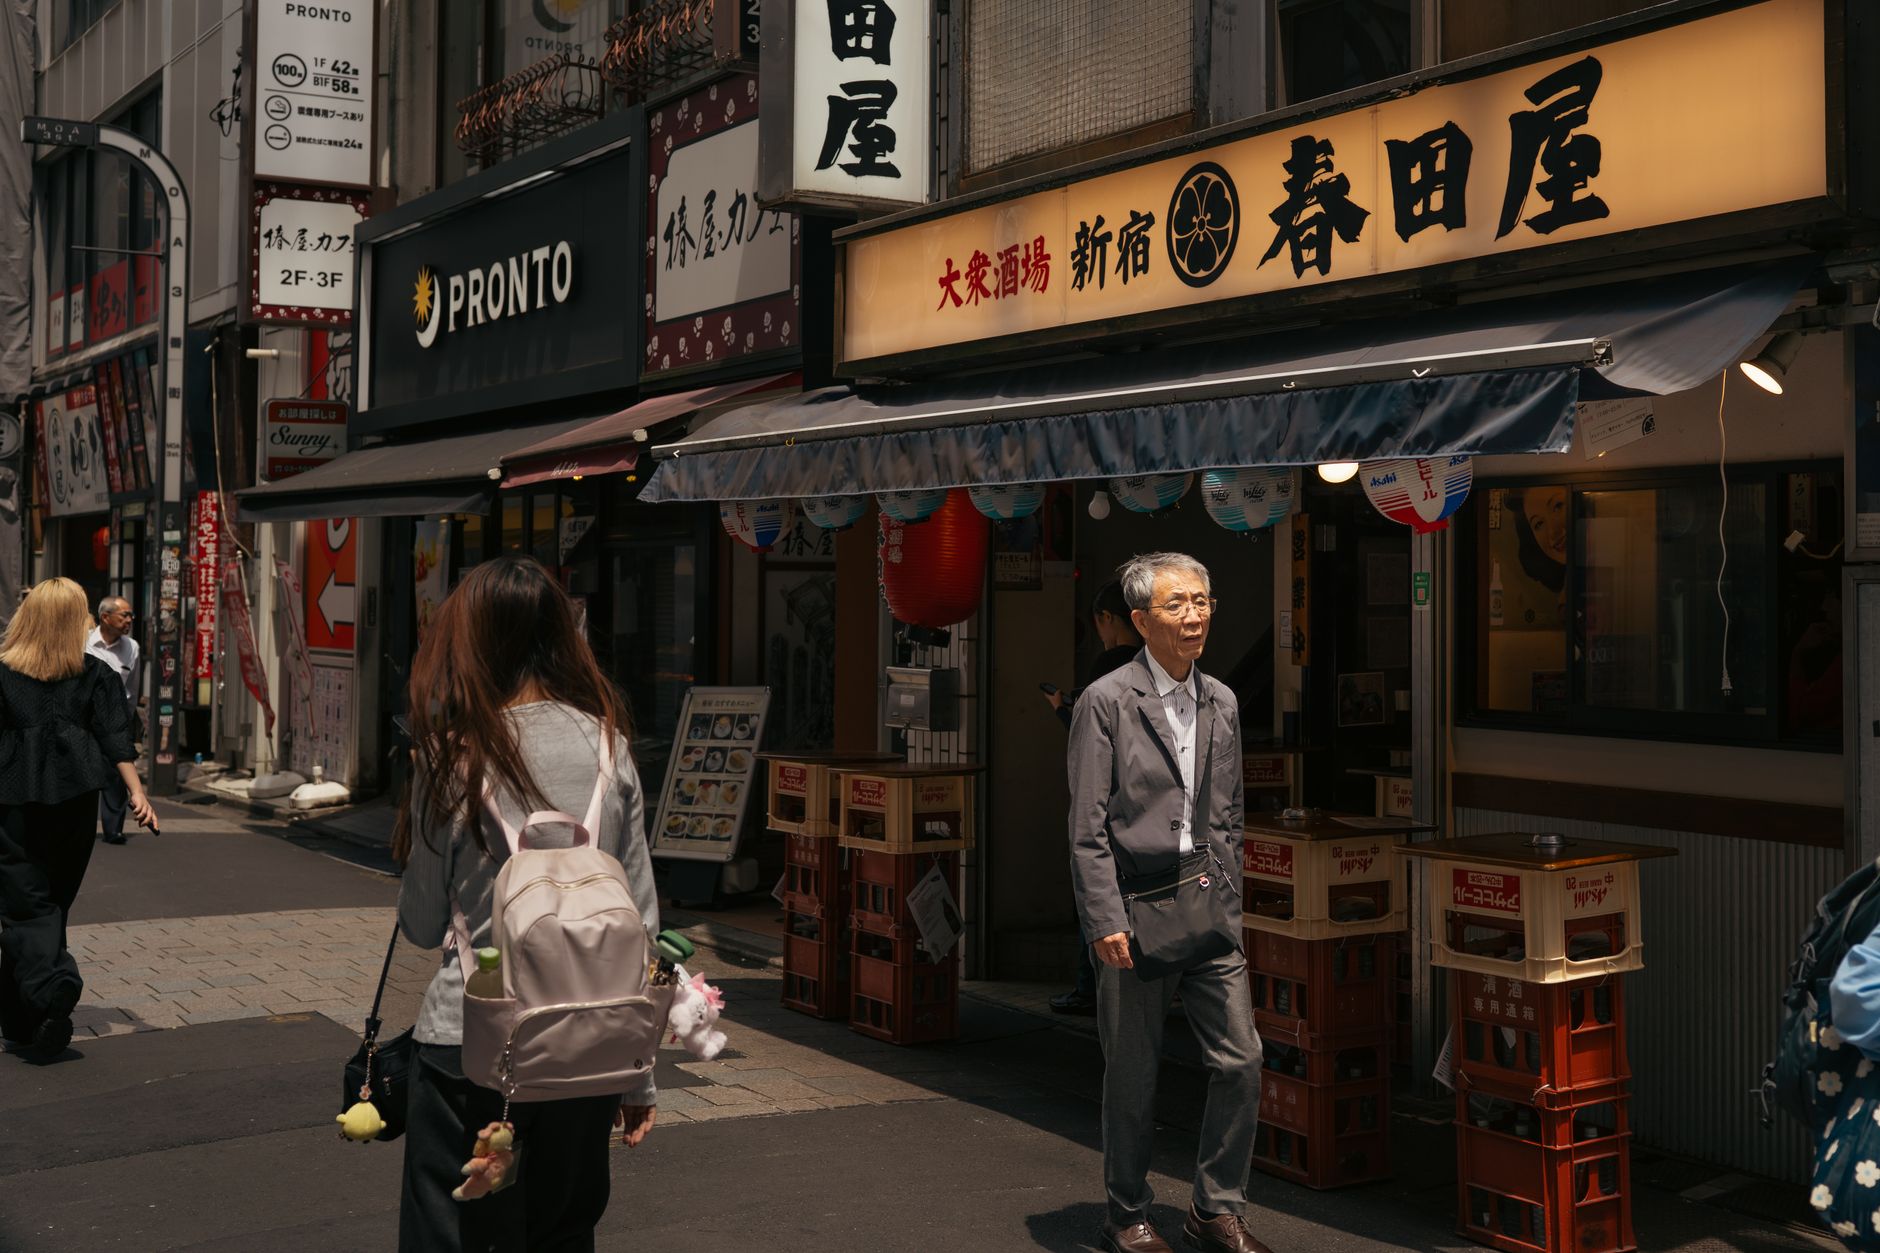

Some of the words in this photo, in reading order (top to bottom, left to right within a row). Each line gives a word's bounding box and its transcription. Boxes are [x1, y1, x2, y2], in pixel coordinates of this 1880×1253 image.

[286, 3, 352, 23] PRONTO
[314, 57, 326, 68] 1F
[313, 76, 330, 87] B1F
[815, 0, 901, 179] 田屋
[1257, 55, 1611, 280] 春田屋
[1070, 210, 1156, 291] 新宿
[937, 235, 1051, 311] 大衆酒場
[448, 240, 575, 333] PRONTO
[270, 425, 331, 456] Sunny
[1370, 472, 1397, 487] Asahi
[782, 521, 833, 556] 椿屋
[1340, 857, 1374, 876] Asahi
[1565, 876, 1576, 890] 20
[1604, 872, 1614, 885] 中
[1454, 886, 1519, 909] アサヒビール
[1574, 887, 1609, 909] Asahi
[1482, 974, 1522, 999] 清酒
[1473, 997, 1535, 1021] 専用通箱
